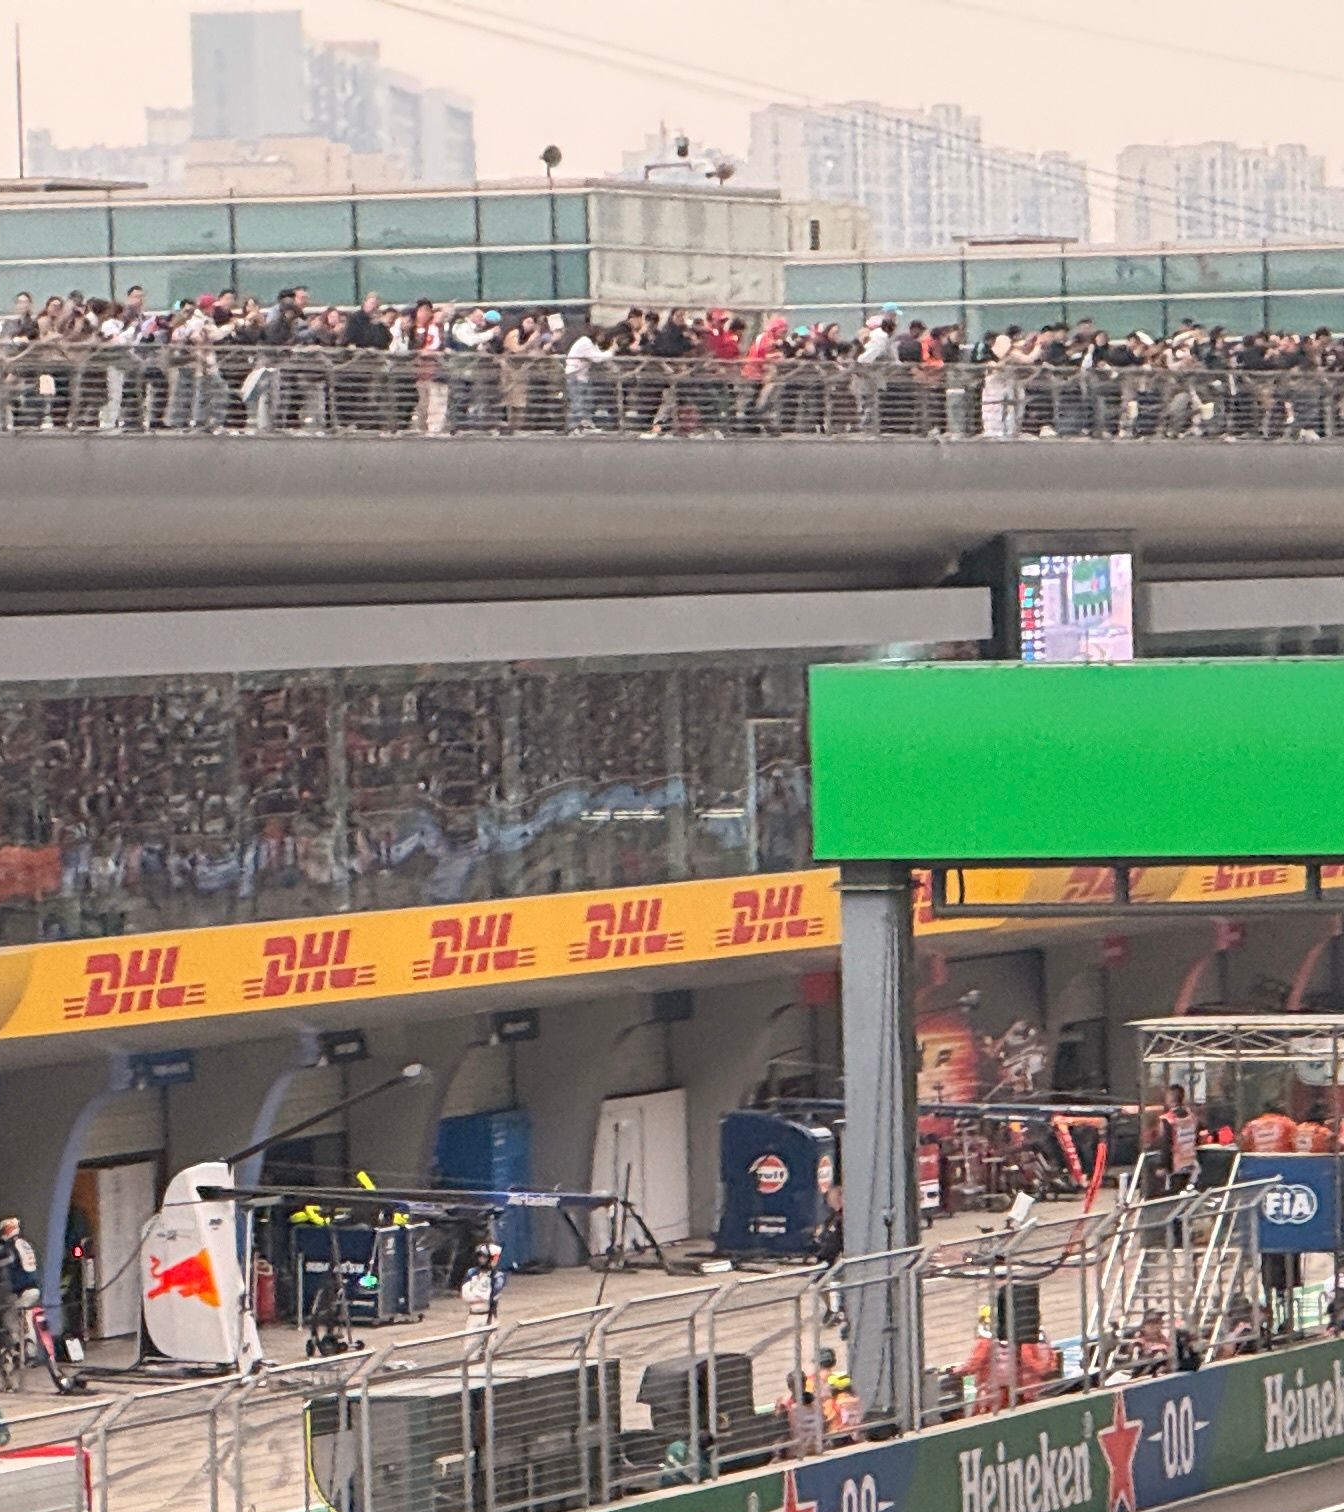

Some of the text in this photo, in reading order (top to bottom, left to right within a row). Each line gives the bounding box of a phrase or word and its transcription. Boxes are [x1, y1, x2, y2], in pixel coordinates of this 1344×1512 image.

[429, 913, 520, 978] DHL
[584, 898, 669, 961] DHL
[731, 884, 810, 945] DHL
[84, 946, 186, 1017] DHL
[263, 929, 358, 998] DHL
